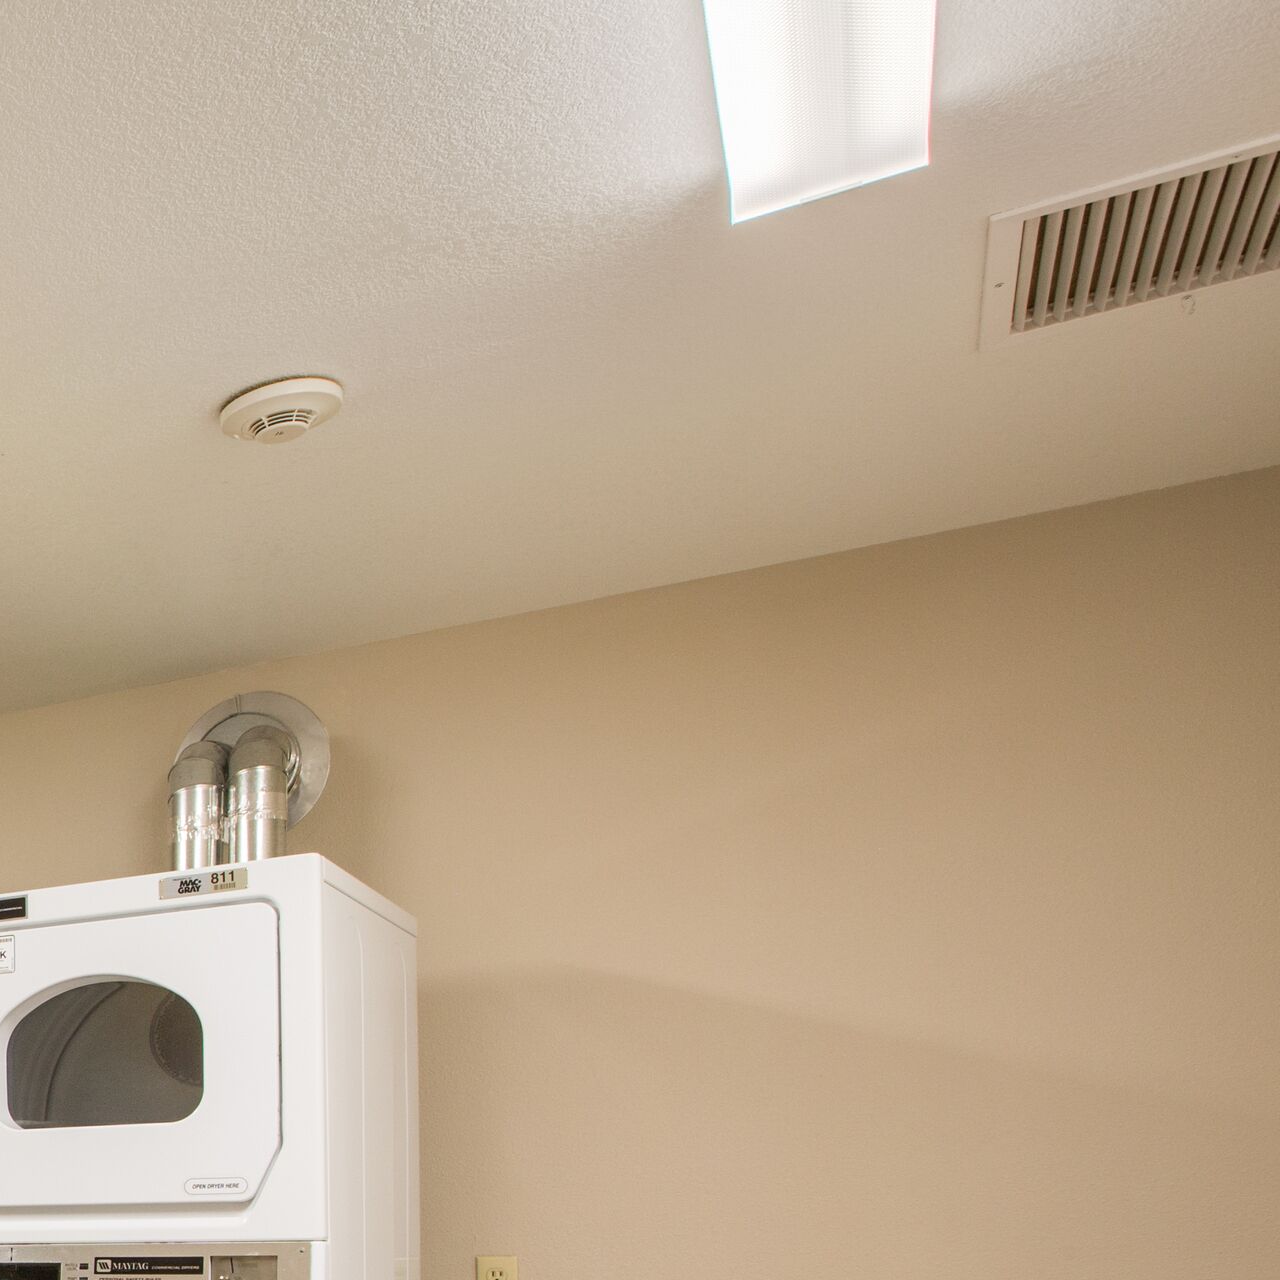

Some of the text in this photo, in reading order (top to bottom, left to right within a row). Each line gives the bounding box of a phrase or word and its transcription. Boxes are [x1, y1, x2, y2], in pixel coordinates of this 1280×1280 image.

[210, 870, 234, 884] 811
[178, 885, 201, 894] GRAY
[112, 1261, 149, 1270] MAYTAG
